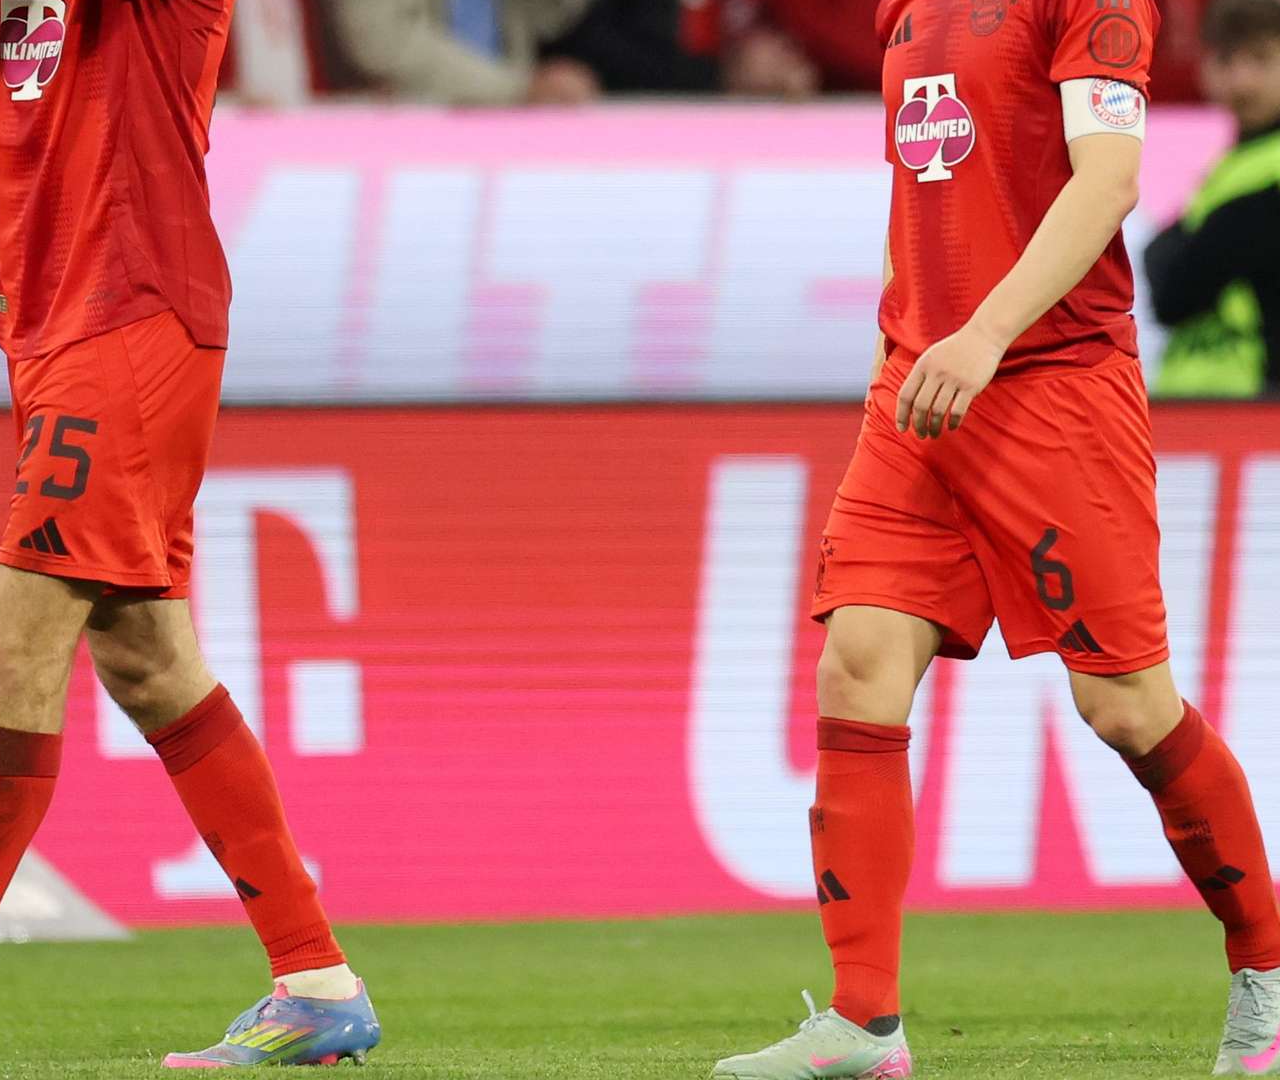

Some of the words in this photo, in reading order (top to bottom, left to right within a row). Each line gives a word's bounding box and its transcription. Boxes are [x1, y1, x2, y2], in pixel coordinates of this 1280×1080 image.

[0, 40, 61, 61] NLIMITED
[897, 118, 970, 143] UNLIMITED
[1030, 528, 1075, 612] 6
